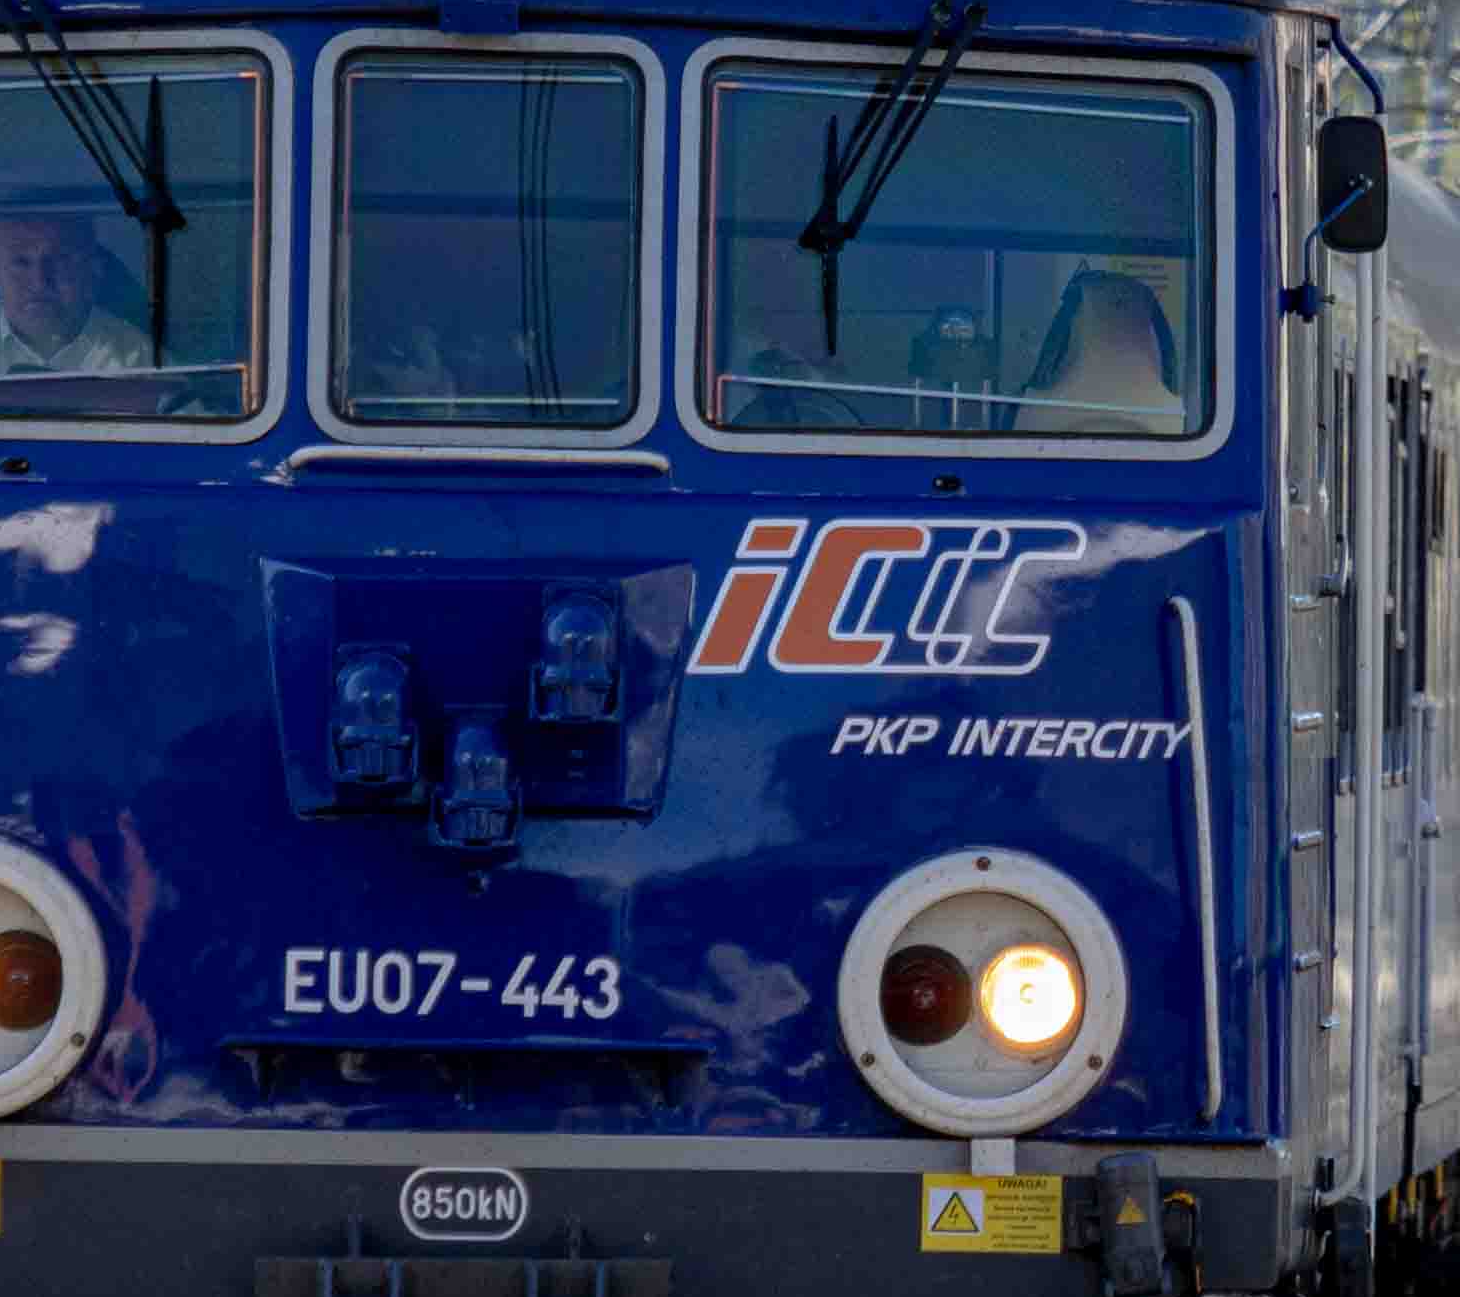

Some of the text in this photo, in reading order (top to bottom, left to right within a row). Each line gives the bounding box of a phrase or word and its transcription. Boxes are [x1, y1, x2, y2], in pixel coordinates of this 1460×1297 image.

[829, 716, 1190, 759] PKP INTERCITY
[284, 948, 621, 1019] EU07-443
[411, 1186, 517, 1221] 850kN
